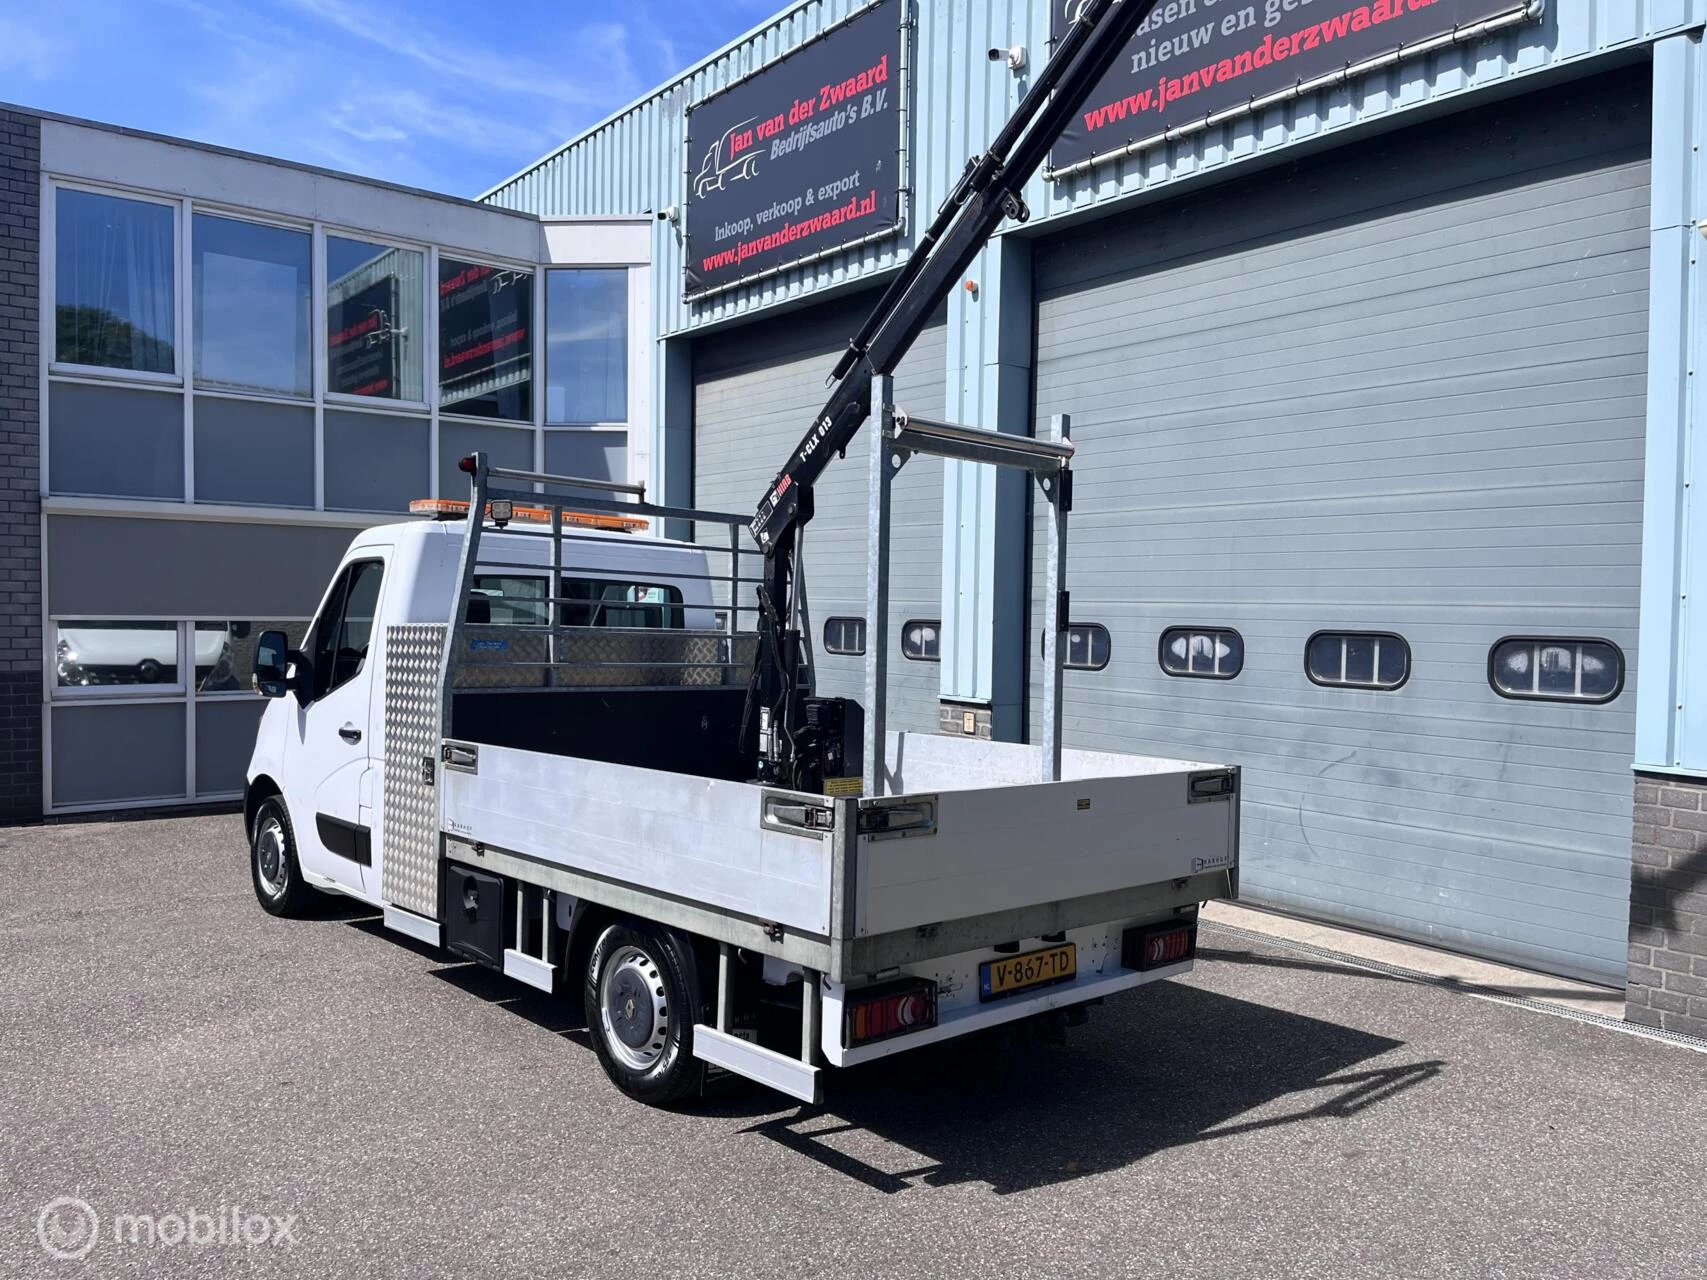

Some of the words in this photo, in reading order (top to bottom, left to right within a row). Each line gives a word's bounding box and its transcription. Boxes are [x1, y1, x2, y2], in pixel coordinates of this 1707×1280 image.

[1131, 22, 1214, 74] nieuw
[1221, 6, 1256, 36] en
[730, 130, 752, 160] Jan
[757, 114, 784, 142] van
[789, 98, 815, 123] der
[820, 55, 888, 110] Zwaard
[770, 104, 858, 160] Bedrijfsauto's
[861, 87, 888, 119] B.V.
[703, 190, 876, 272] www.janvanderzwaard.nl
[715, 216, 754, 242] Inkoop,
[756, 195, 802, 225] verkoop
[805, 188, 815, 205] &
[818, 170, 860, 202] export
[800, 433, 820, 462] T-CLX
[818, 416, 833, 436] 013
[996, 951, 1069, 987] V-867-TD
